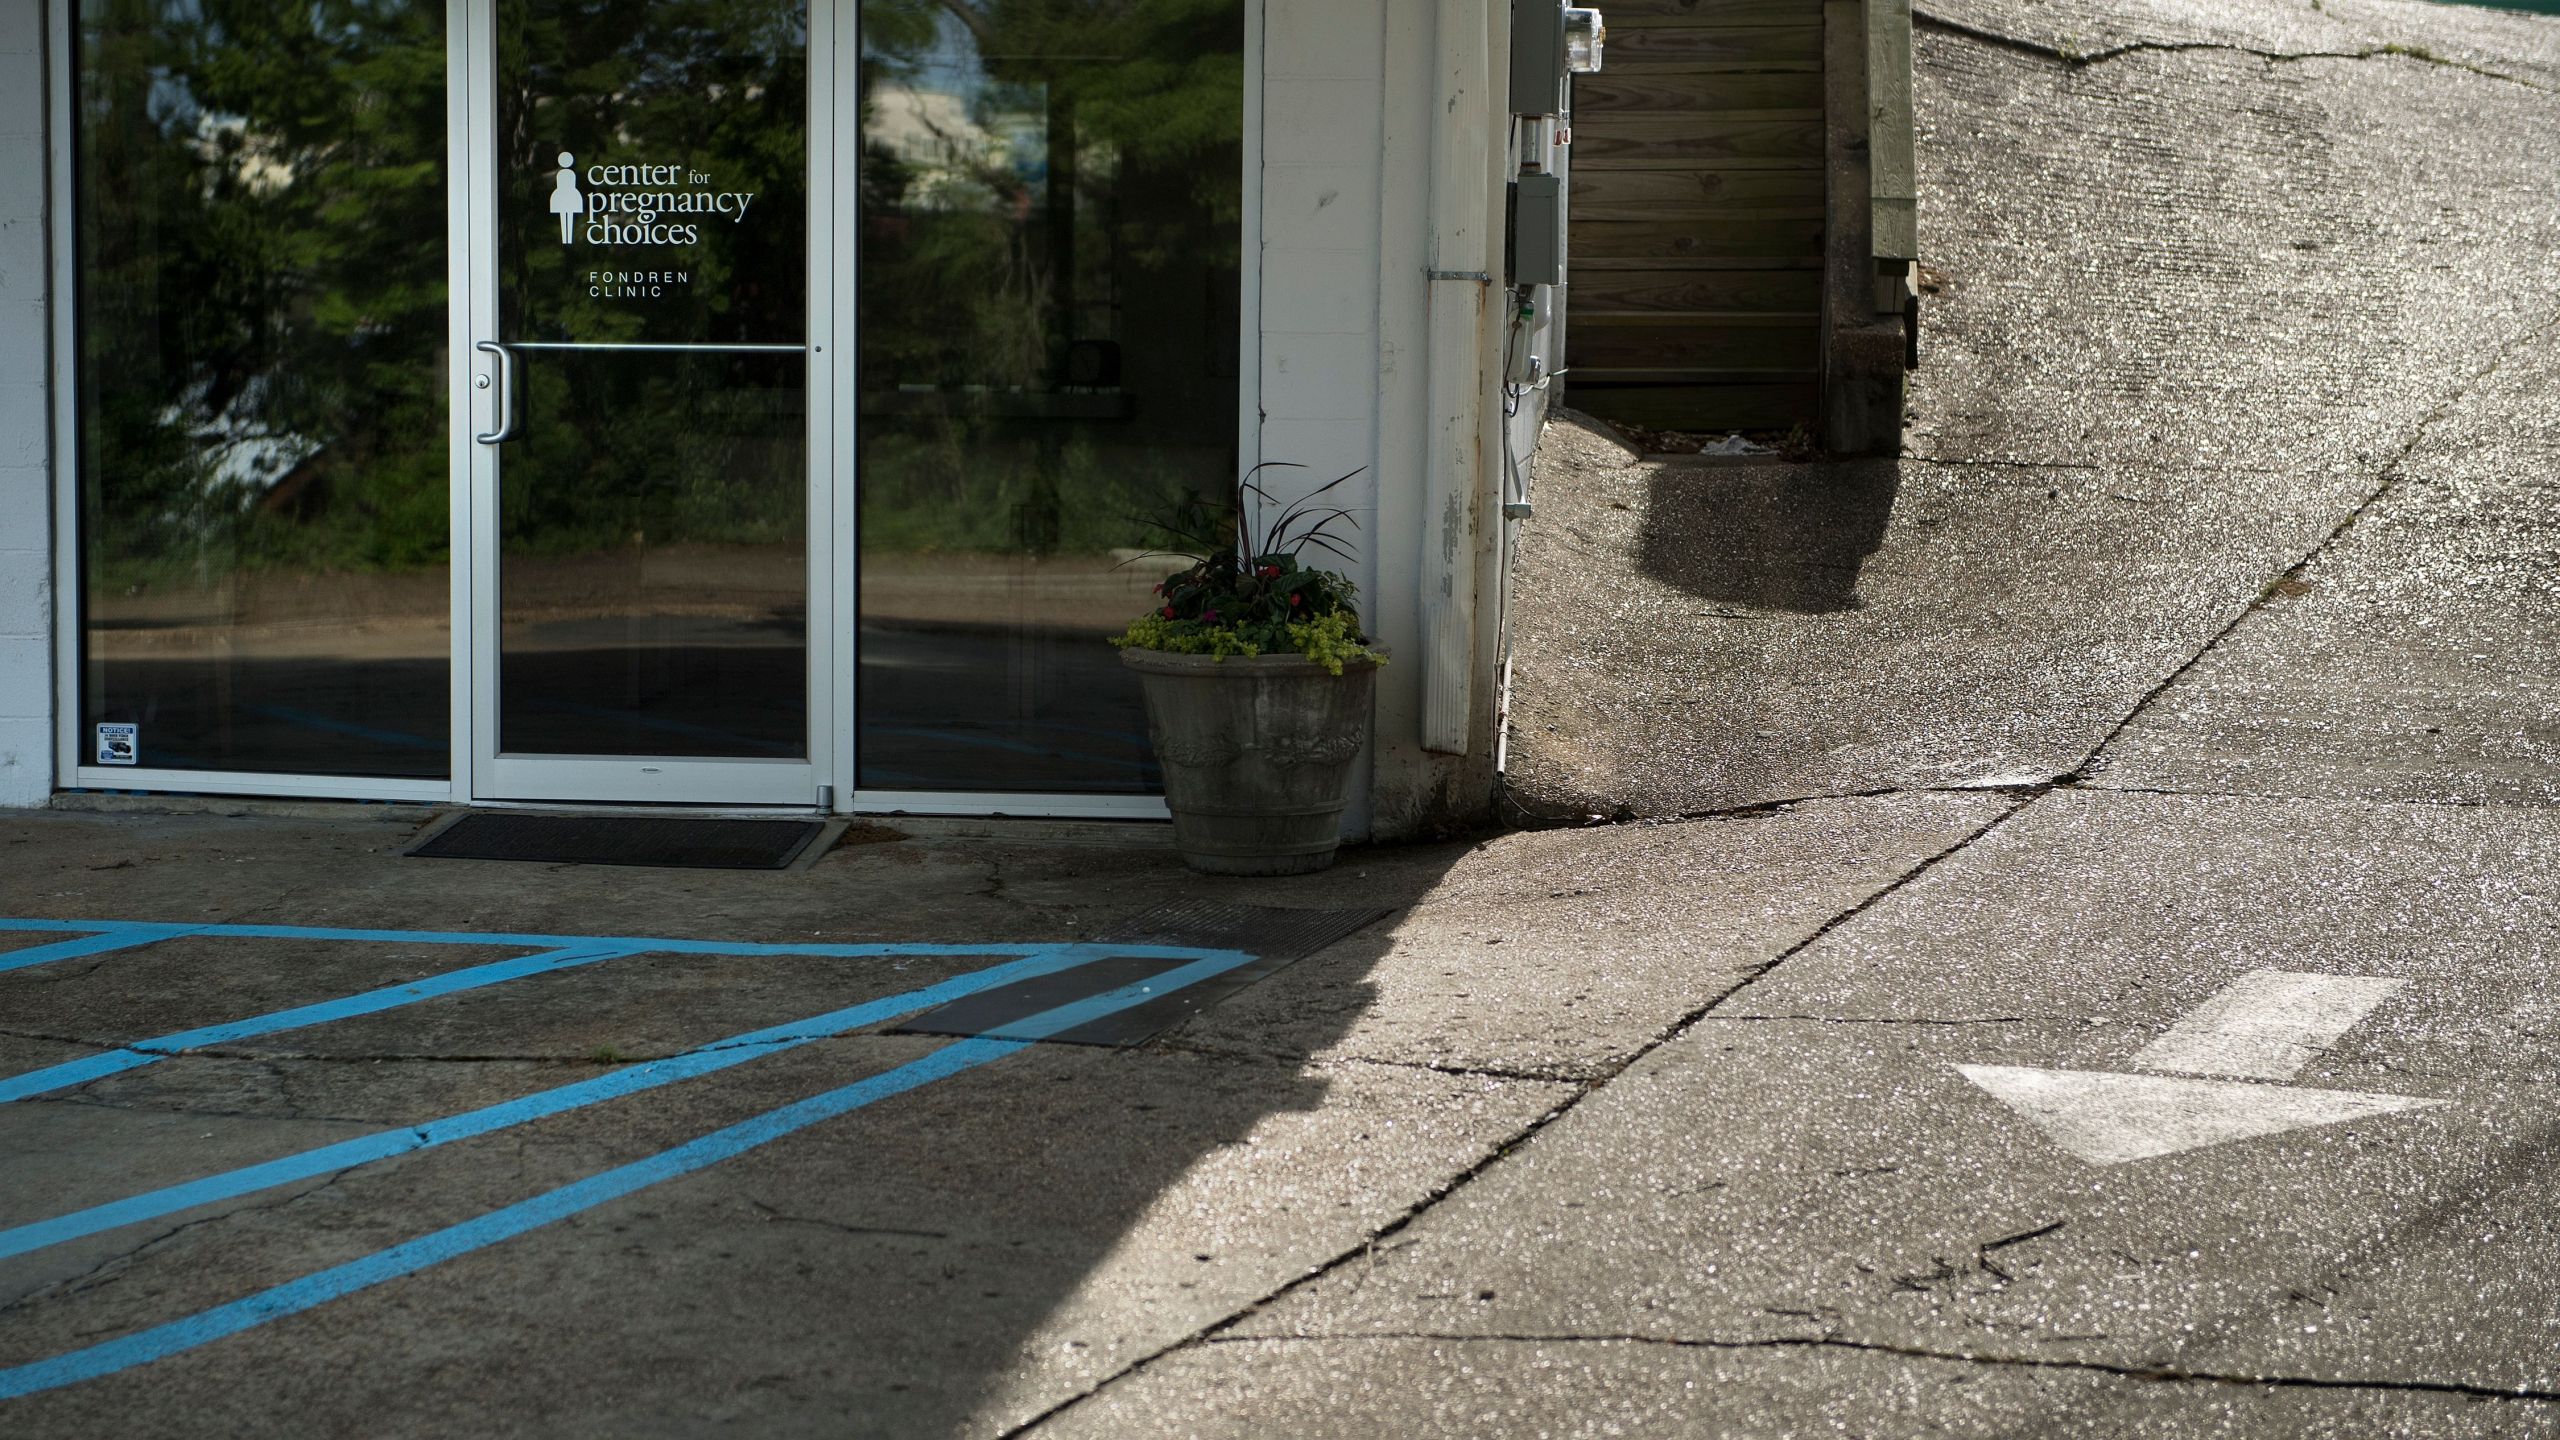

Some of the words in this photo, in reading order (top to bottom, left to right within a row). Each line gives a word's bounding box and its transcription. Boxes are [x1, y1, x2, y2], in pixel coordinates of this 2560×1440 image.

[587, 163, 681, 186] center
[688, 169, 711, 184] for
[587, 192, 754, 223] pregnancy
[586, 215, 697, 245] choices
[589, 271, 688, 283] FONDREN
[589, 286, 661, 297] CLINIC
